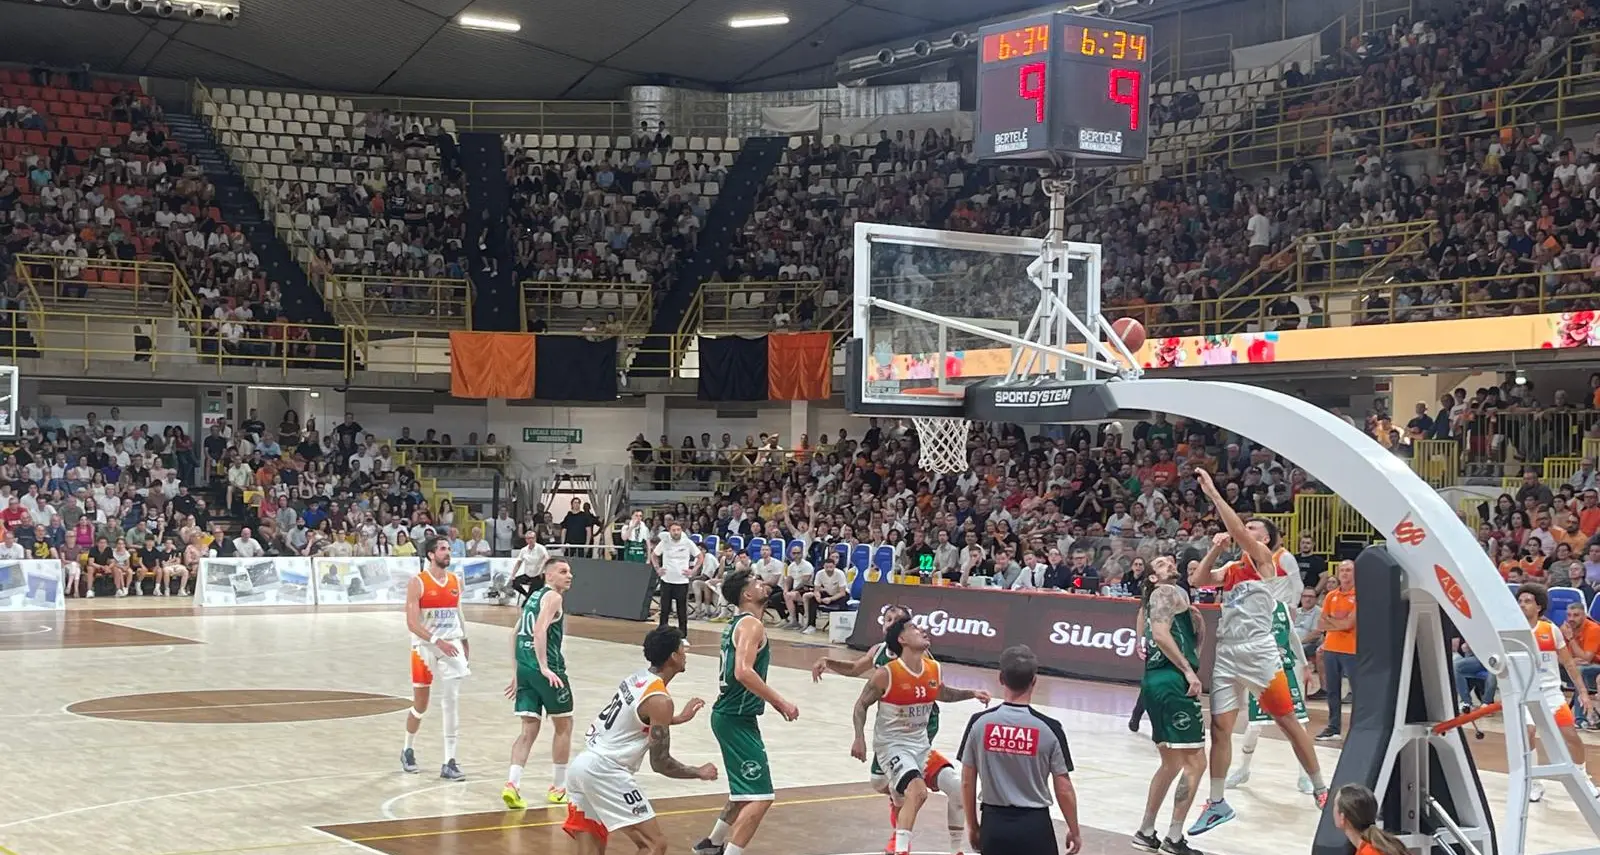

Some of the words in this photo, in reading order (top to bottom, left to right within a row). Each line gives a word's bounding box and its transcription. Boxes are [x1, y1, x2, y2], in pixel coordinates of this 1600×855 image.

[998, 24, 1050, 61] 6:34
[1080, 27, 1147, 60] 6:34
[1019, 61, 1046, 123] 9
[1108, 68, 1140, 131] 9
[994, 388, 1072, 406] SPORTSYSTEM
[919, 555, 933, 570] 22
[877, 605, 996, 637] aGum
[914, 686, 927, 699] 33
[990, 725, 1033, 742] ATTAL
[989, 738, 1033, 751] GROUP
[623, 789, 643, 805] 00
